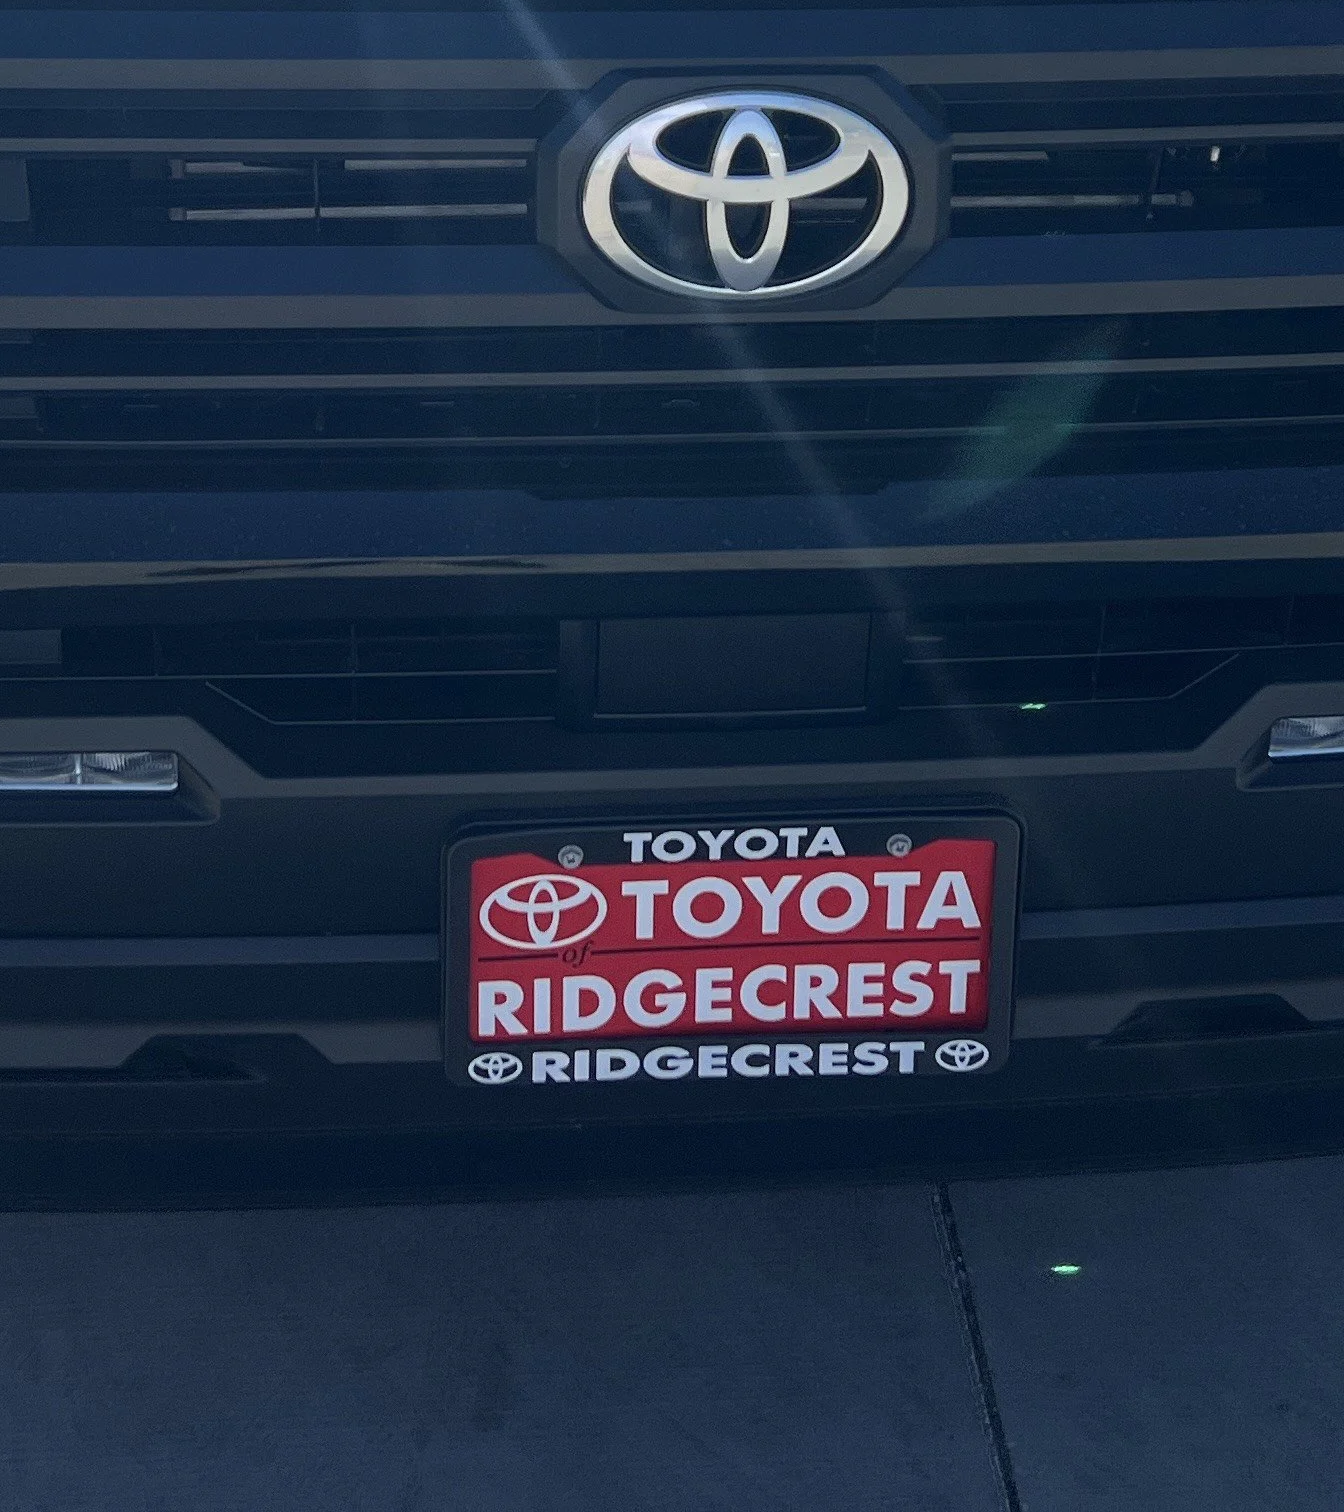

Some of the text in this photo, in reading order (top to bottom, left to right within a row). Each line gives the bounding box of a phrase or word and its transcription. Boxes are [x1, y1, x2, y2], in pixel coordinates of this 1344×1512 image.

[623, 826, 846, 864] TOYOTA
[621, 870, 981, 940] TOYOTA
[561, 941, 592, 967] of
[478, 959, 981, 1036] RIDGECREST
[531, 1041, 925, 1083] RIDGECREST
